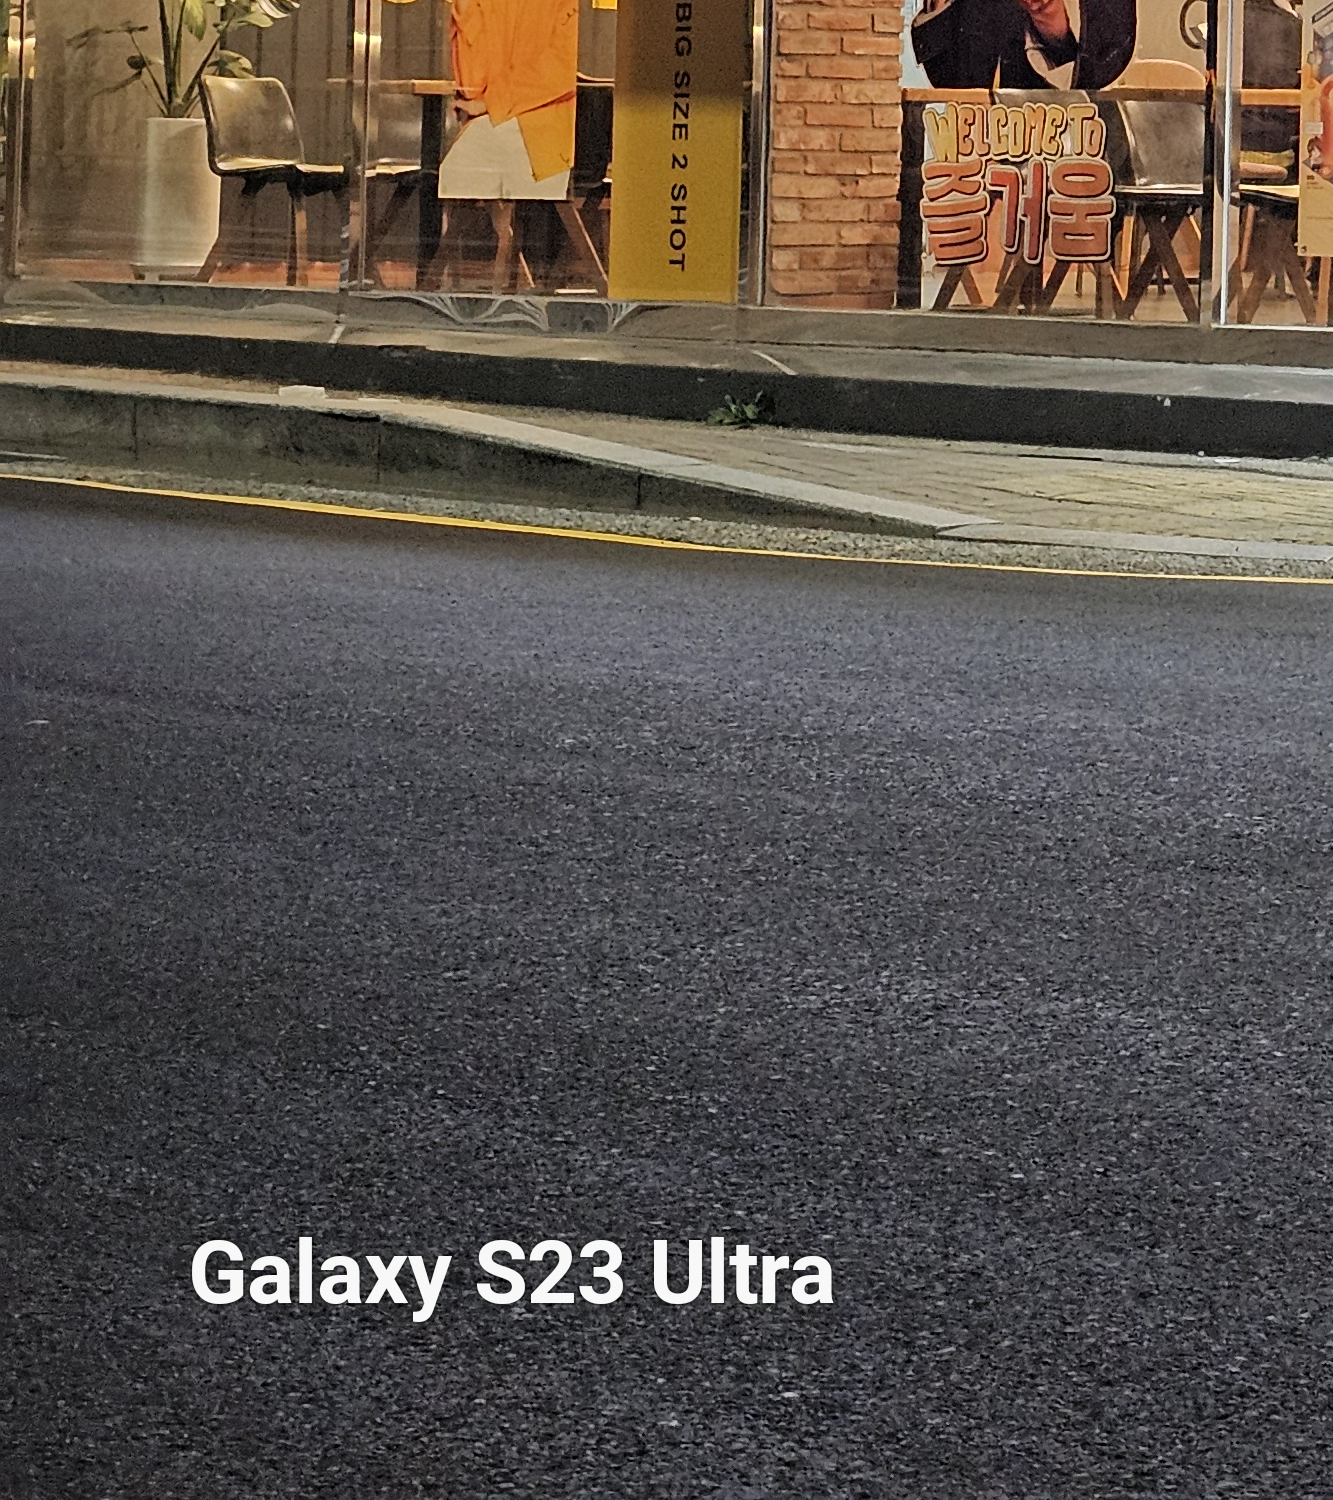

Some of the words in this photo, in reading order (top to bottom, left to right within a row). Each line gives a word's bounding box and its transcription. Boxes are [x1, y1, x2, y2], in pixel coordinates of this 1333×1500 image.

[674, 2, 692, 59] BIG
[672, 73, 691, 141] SIZE
[671, 154, 688, 170] 2
[668, 187, 687, 272] SHOT
[921, 157, 1115, 265] 즐거움
